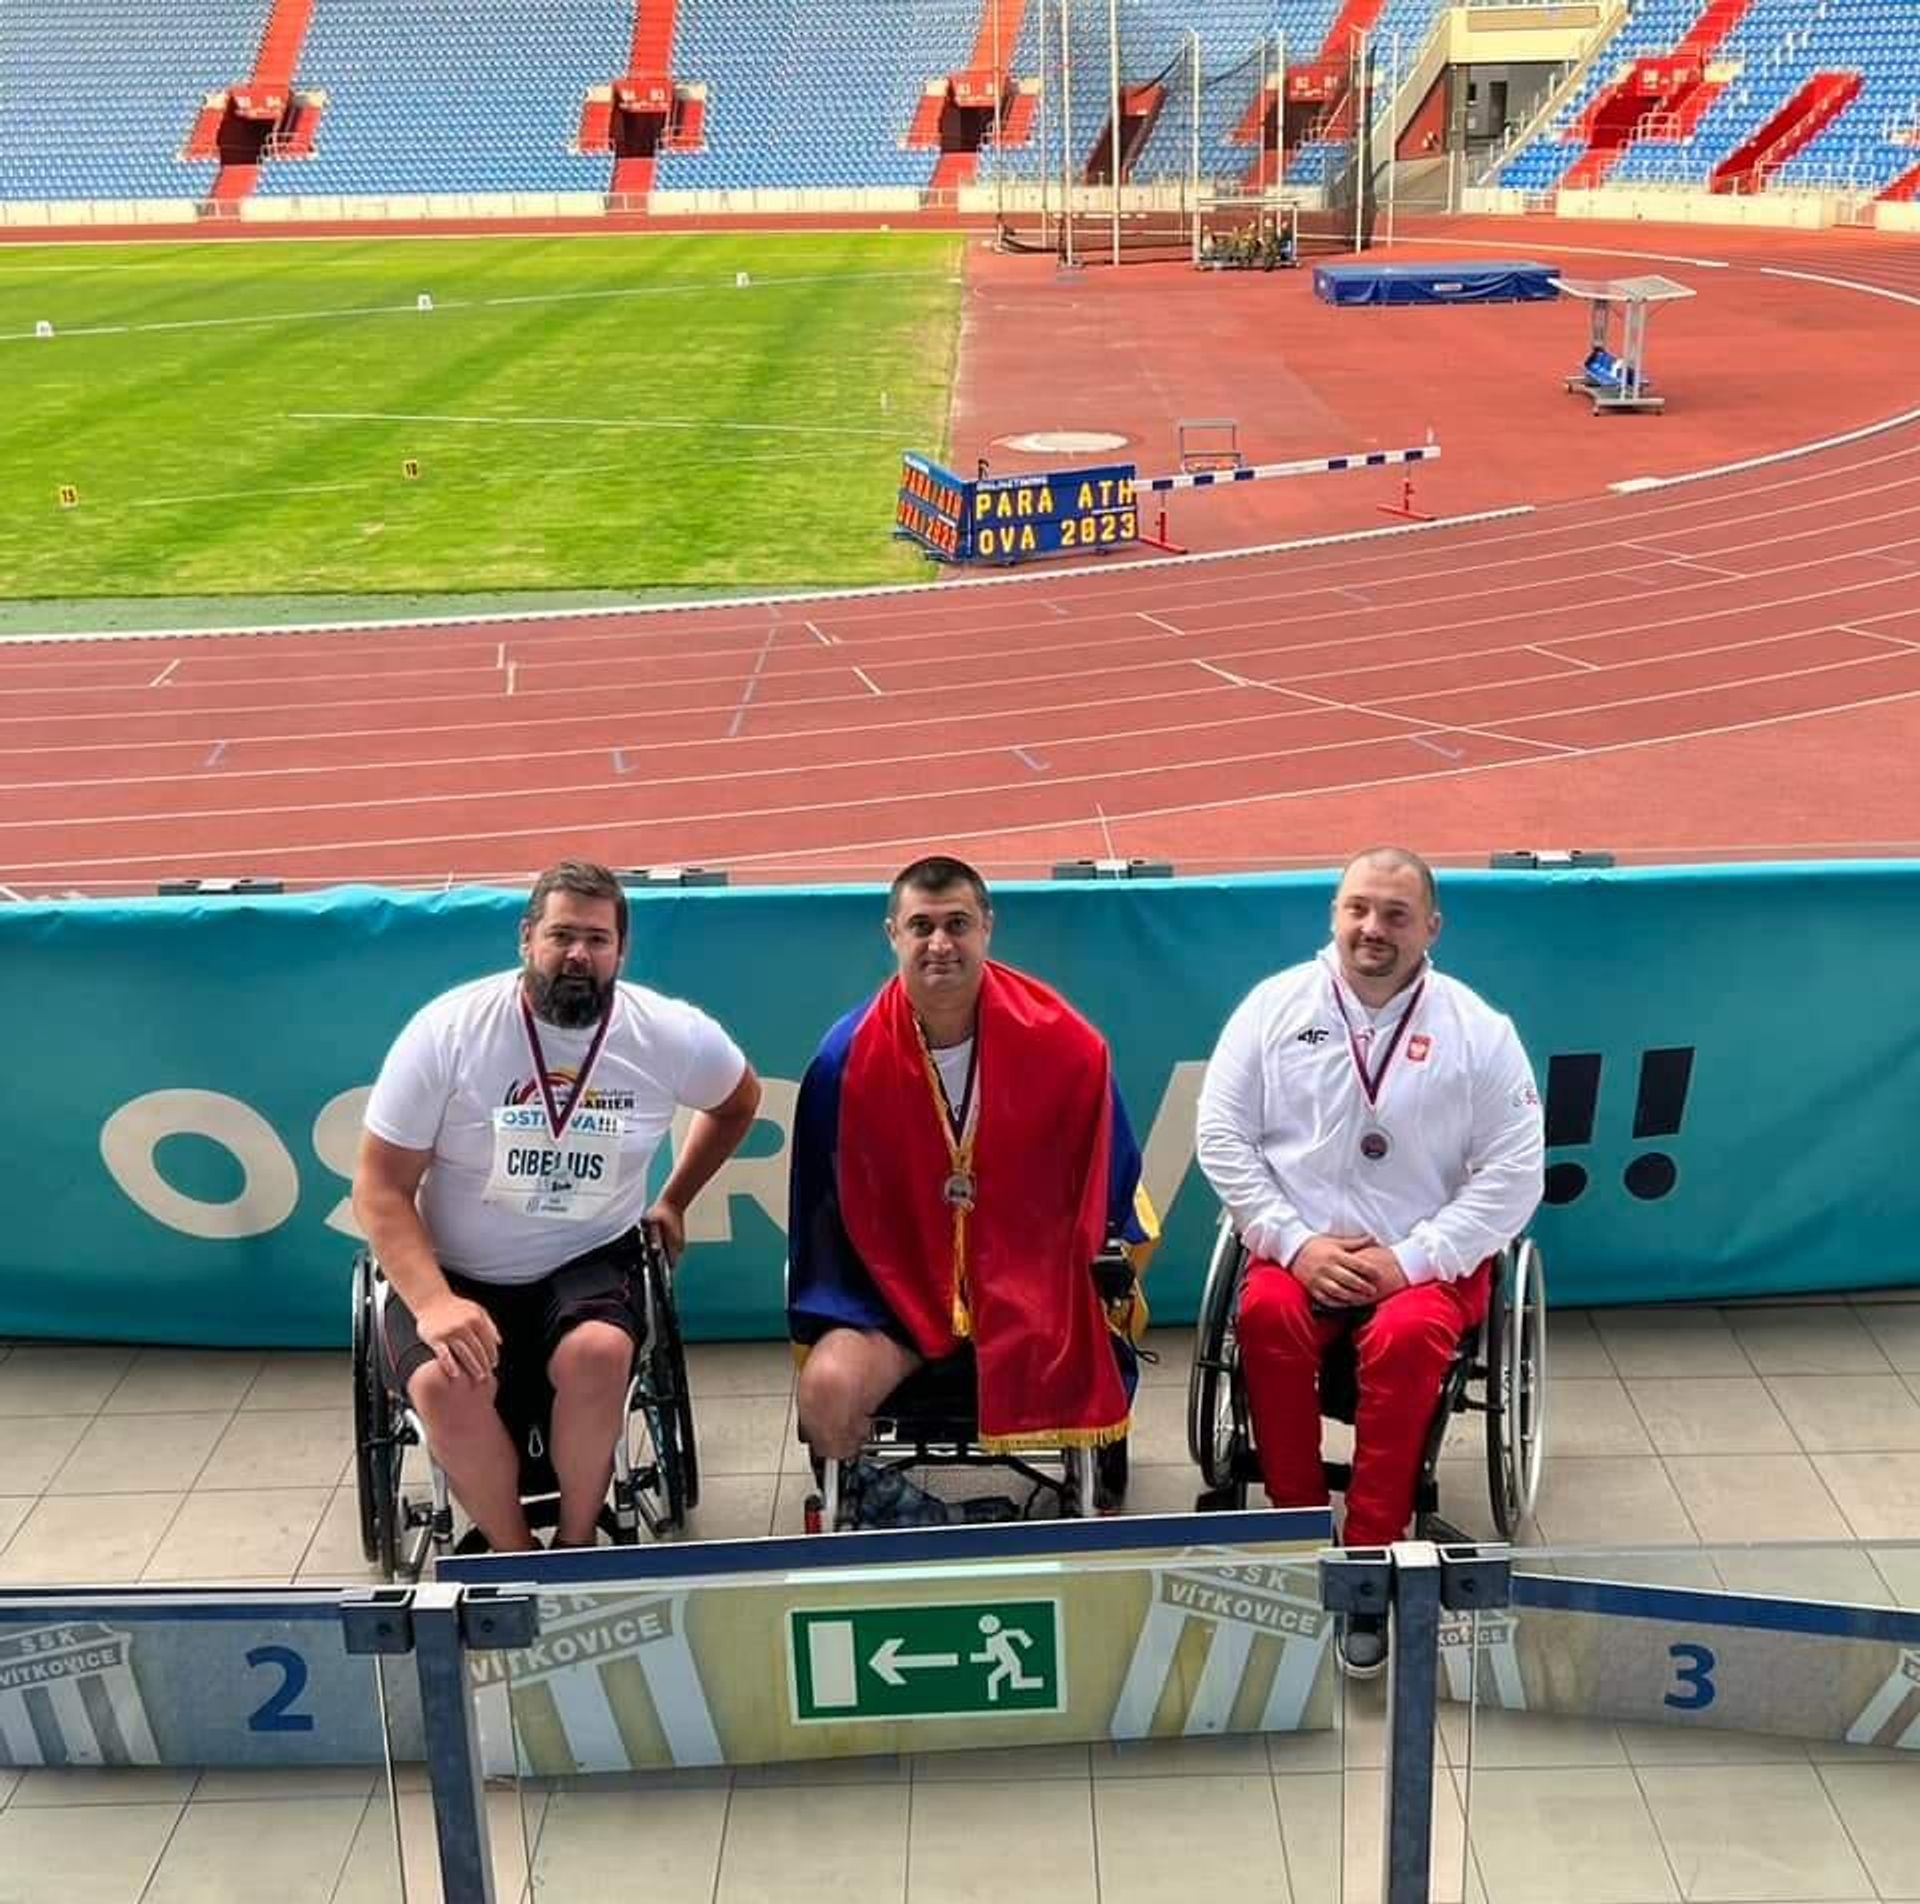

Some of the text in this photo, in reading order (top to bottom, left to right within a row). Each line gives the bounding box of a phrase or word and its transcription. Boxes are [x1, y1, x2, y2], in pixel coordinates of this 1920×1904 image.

[976, 488, 1053, 520] PARA
[1078, 478, 1136, 509] ATH
[979, 511, 1136, 554] OVA 2023
[1298, 1029, 1329, 1044] 4F
[503, 1110, 617, 1132] OSTVA!!!
[245, 1645, 315, 1732] 2
[1664, 1643, 1716, 1710] 3
